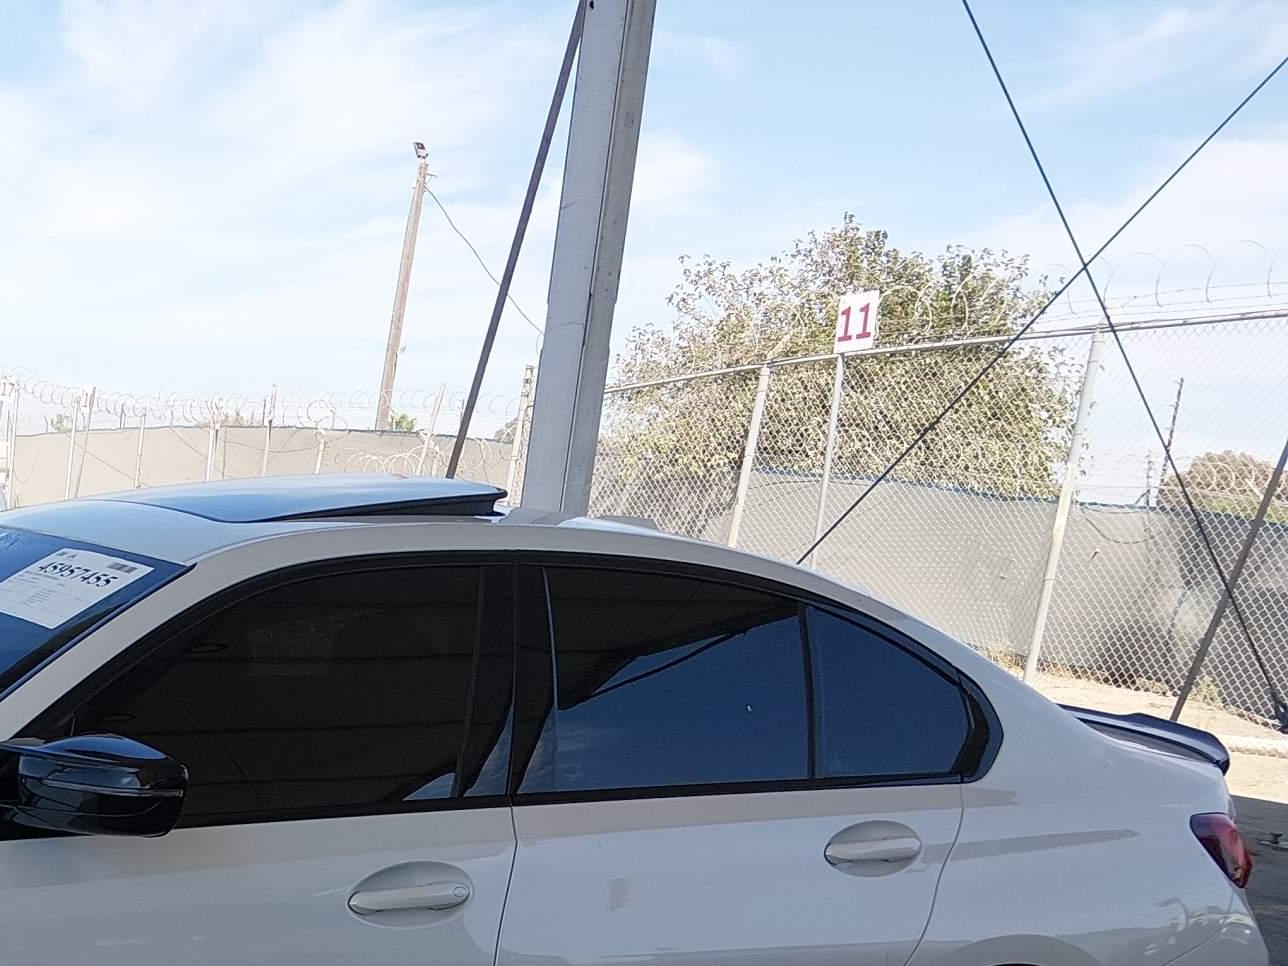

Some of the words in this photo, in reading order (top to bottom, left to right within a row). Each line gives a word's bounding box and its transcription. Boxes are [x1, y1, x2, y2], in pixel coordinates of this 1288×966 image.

[837, 303, 871, 342] 11
[0, 382, 16, 398] 17
[37, 561, 120, 588] 45957455
